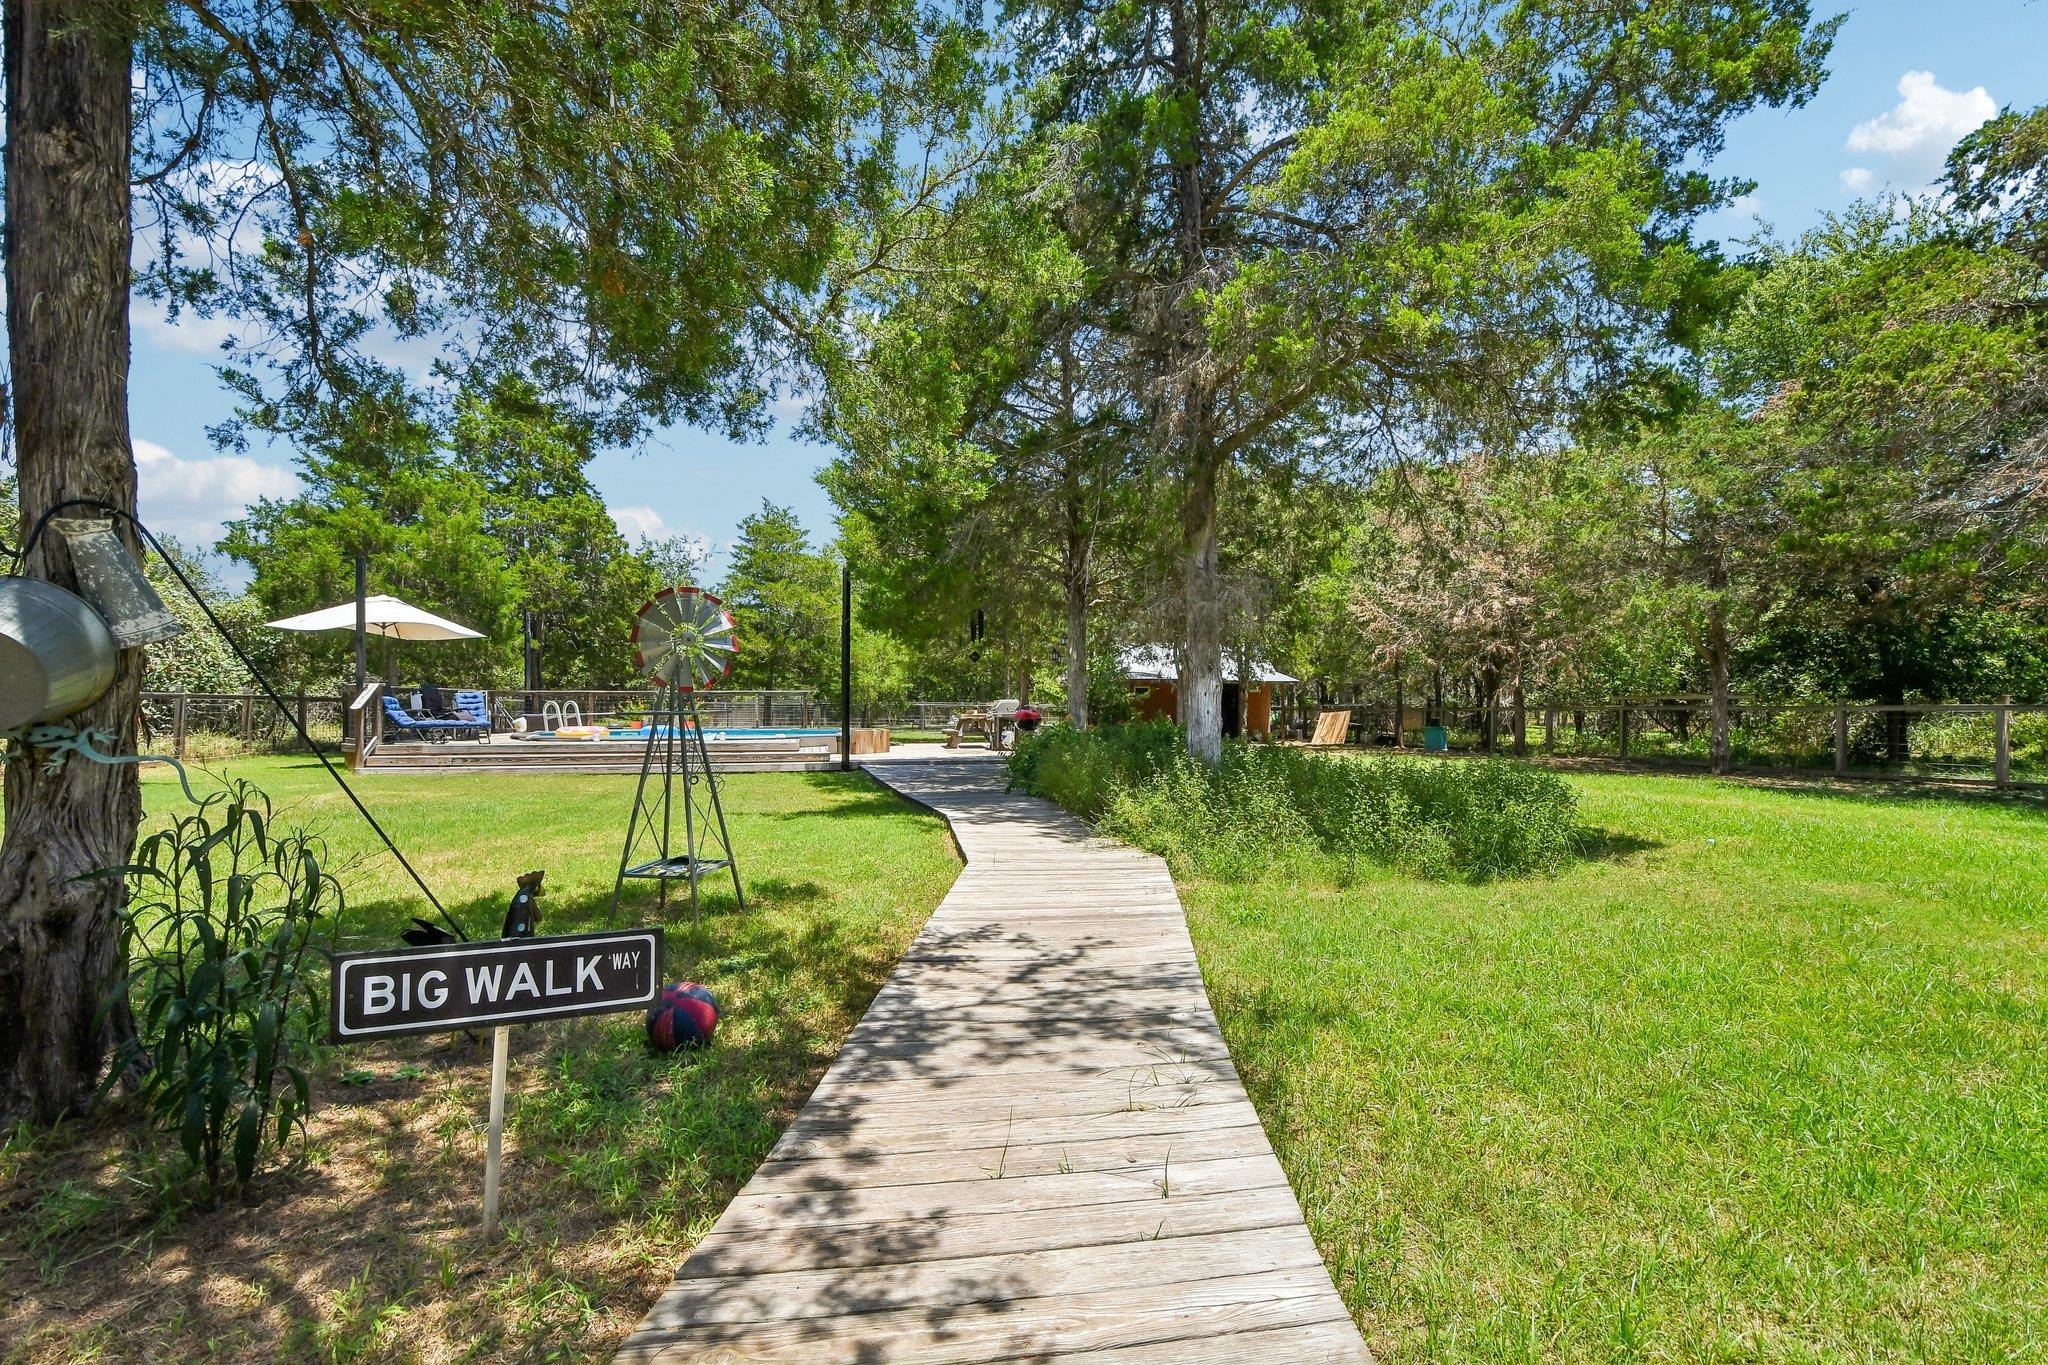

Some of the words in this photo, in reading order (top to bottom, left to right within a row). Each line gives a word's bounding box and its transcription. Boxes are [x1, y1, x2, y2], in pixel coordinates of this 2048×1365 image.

[363, 970, 449, 1015] BIG
[465, 955, 605, 1005] WALK
[612, 950, 641, 970] WAY
